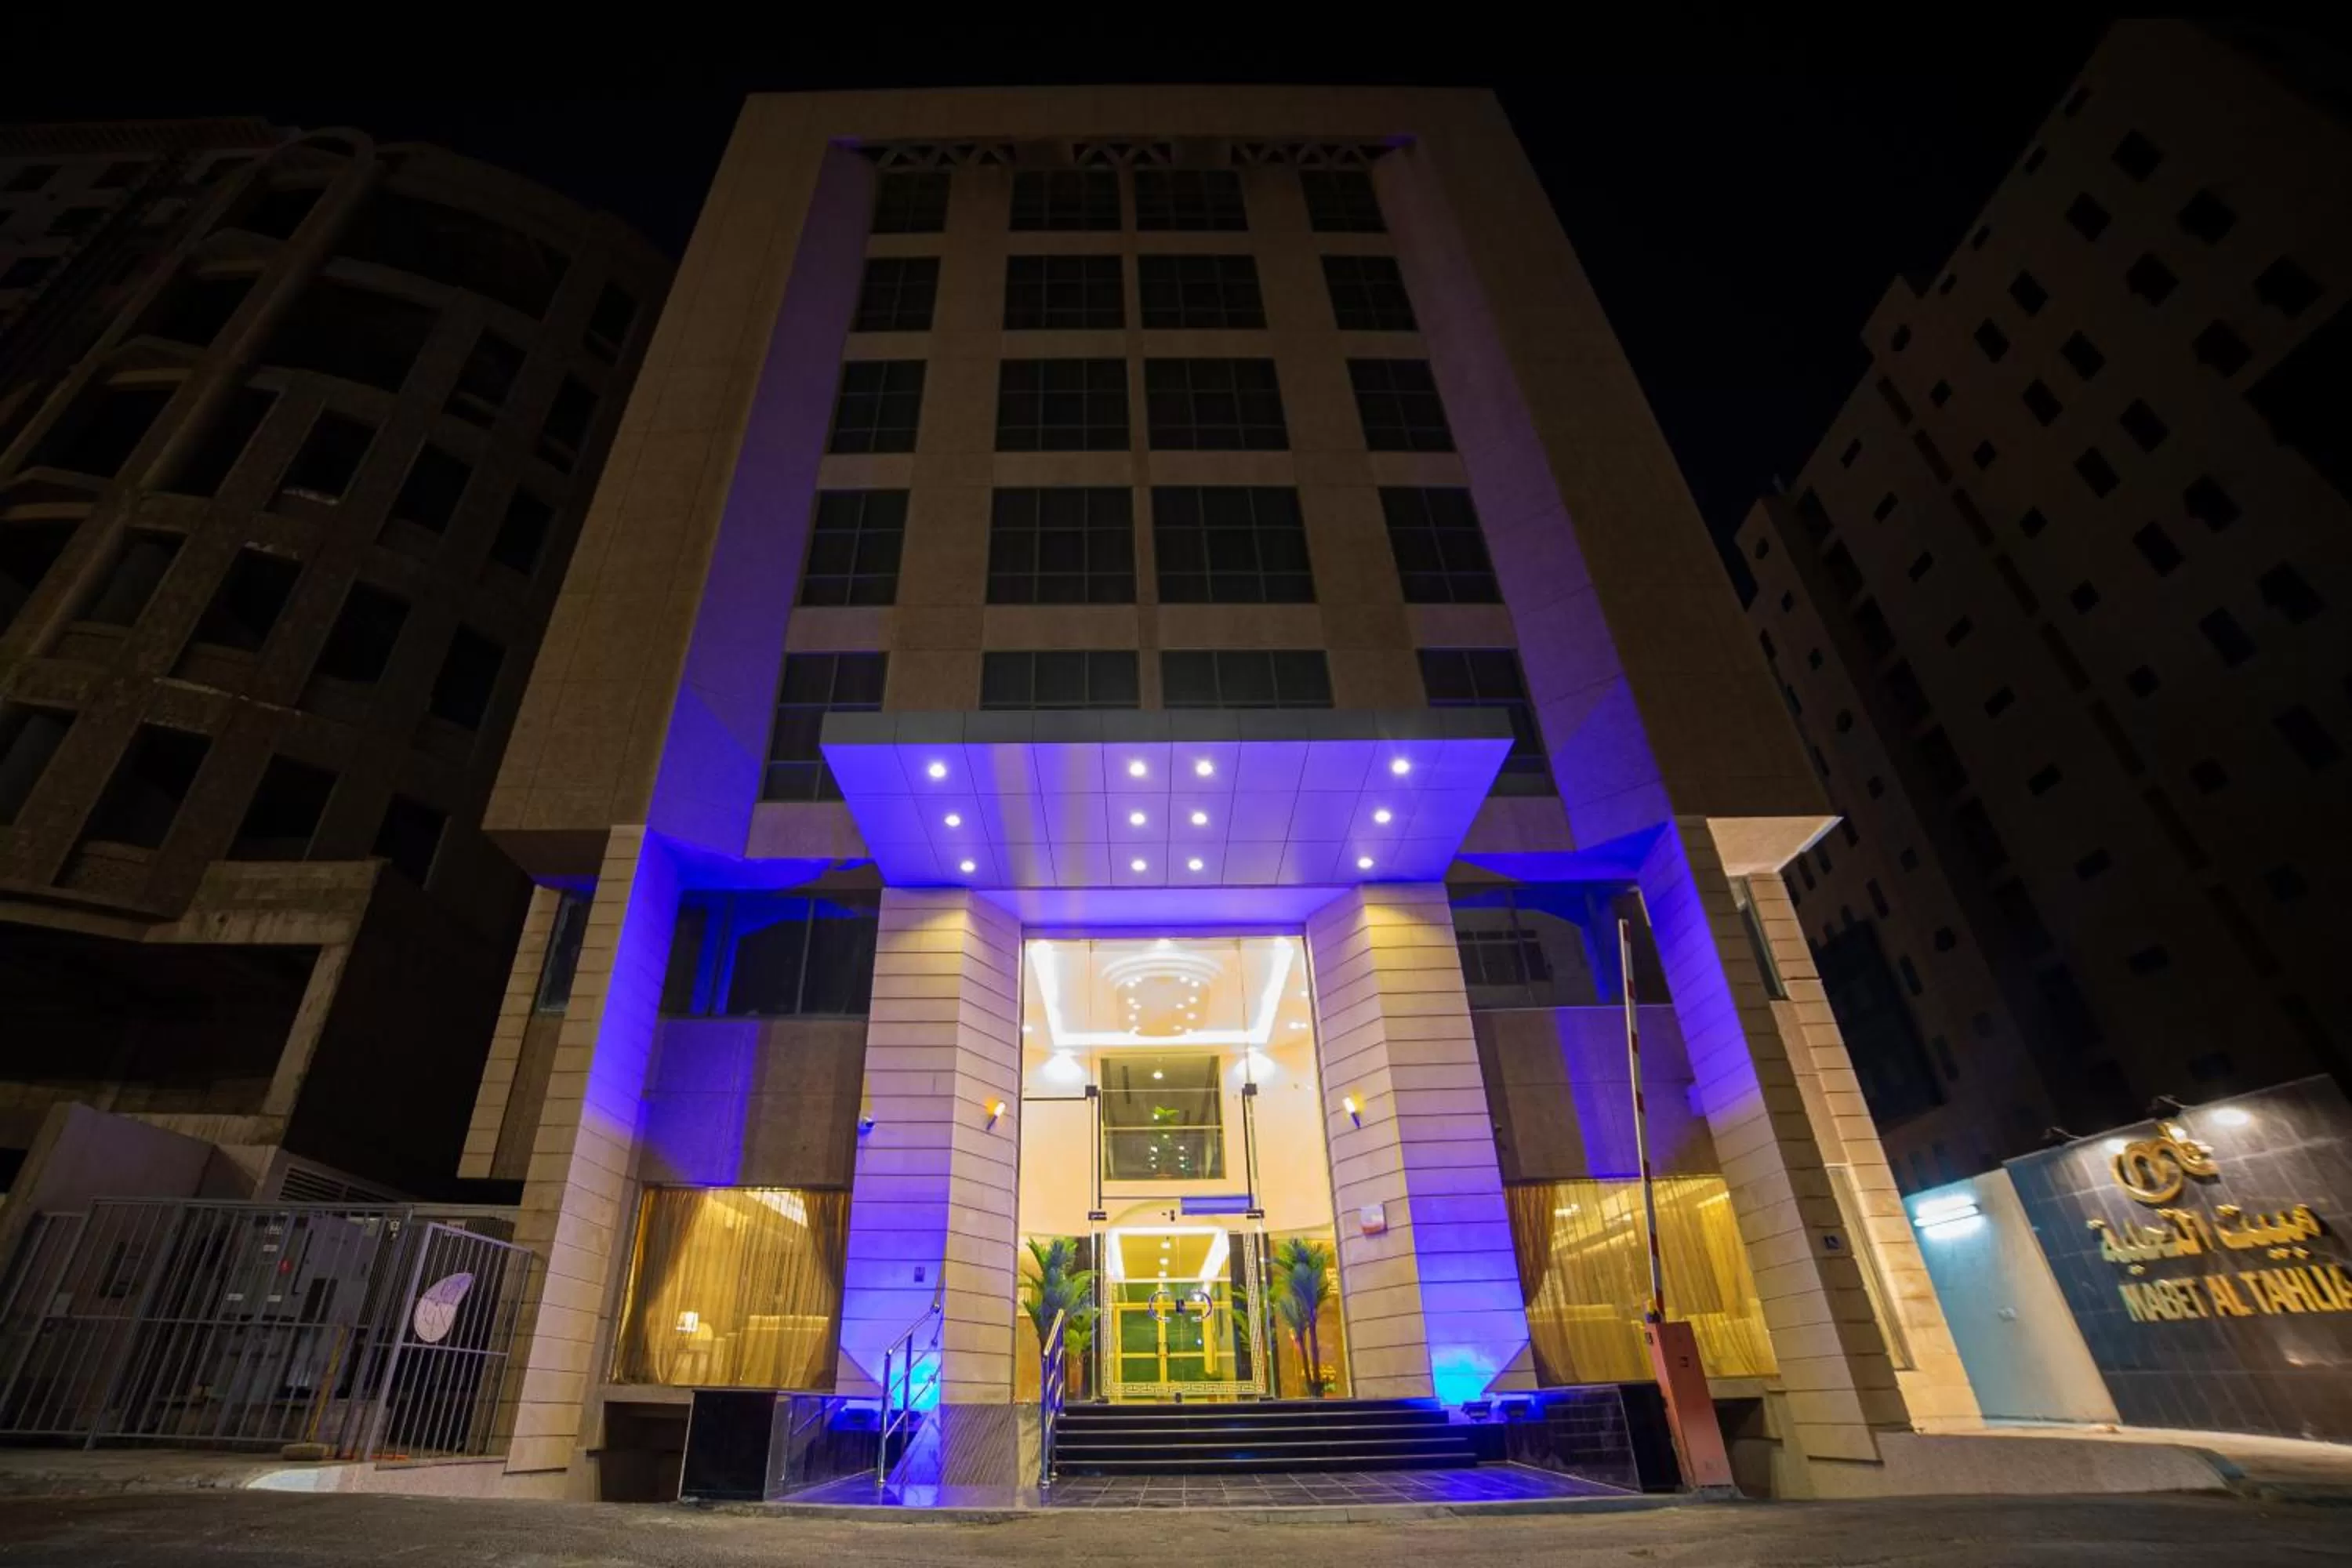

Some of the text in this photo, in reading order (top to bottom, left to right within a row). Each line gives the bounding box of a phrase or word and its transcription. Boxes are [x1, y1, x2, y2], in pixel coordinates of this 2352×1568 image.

[2086, 1204, 2321, 1276] مبيت التحلية
[2118, 1278, 2209, 1322] MABET
[2204, 1272, 2253, 1316] AL
